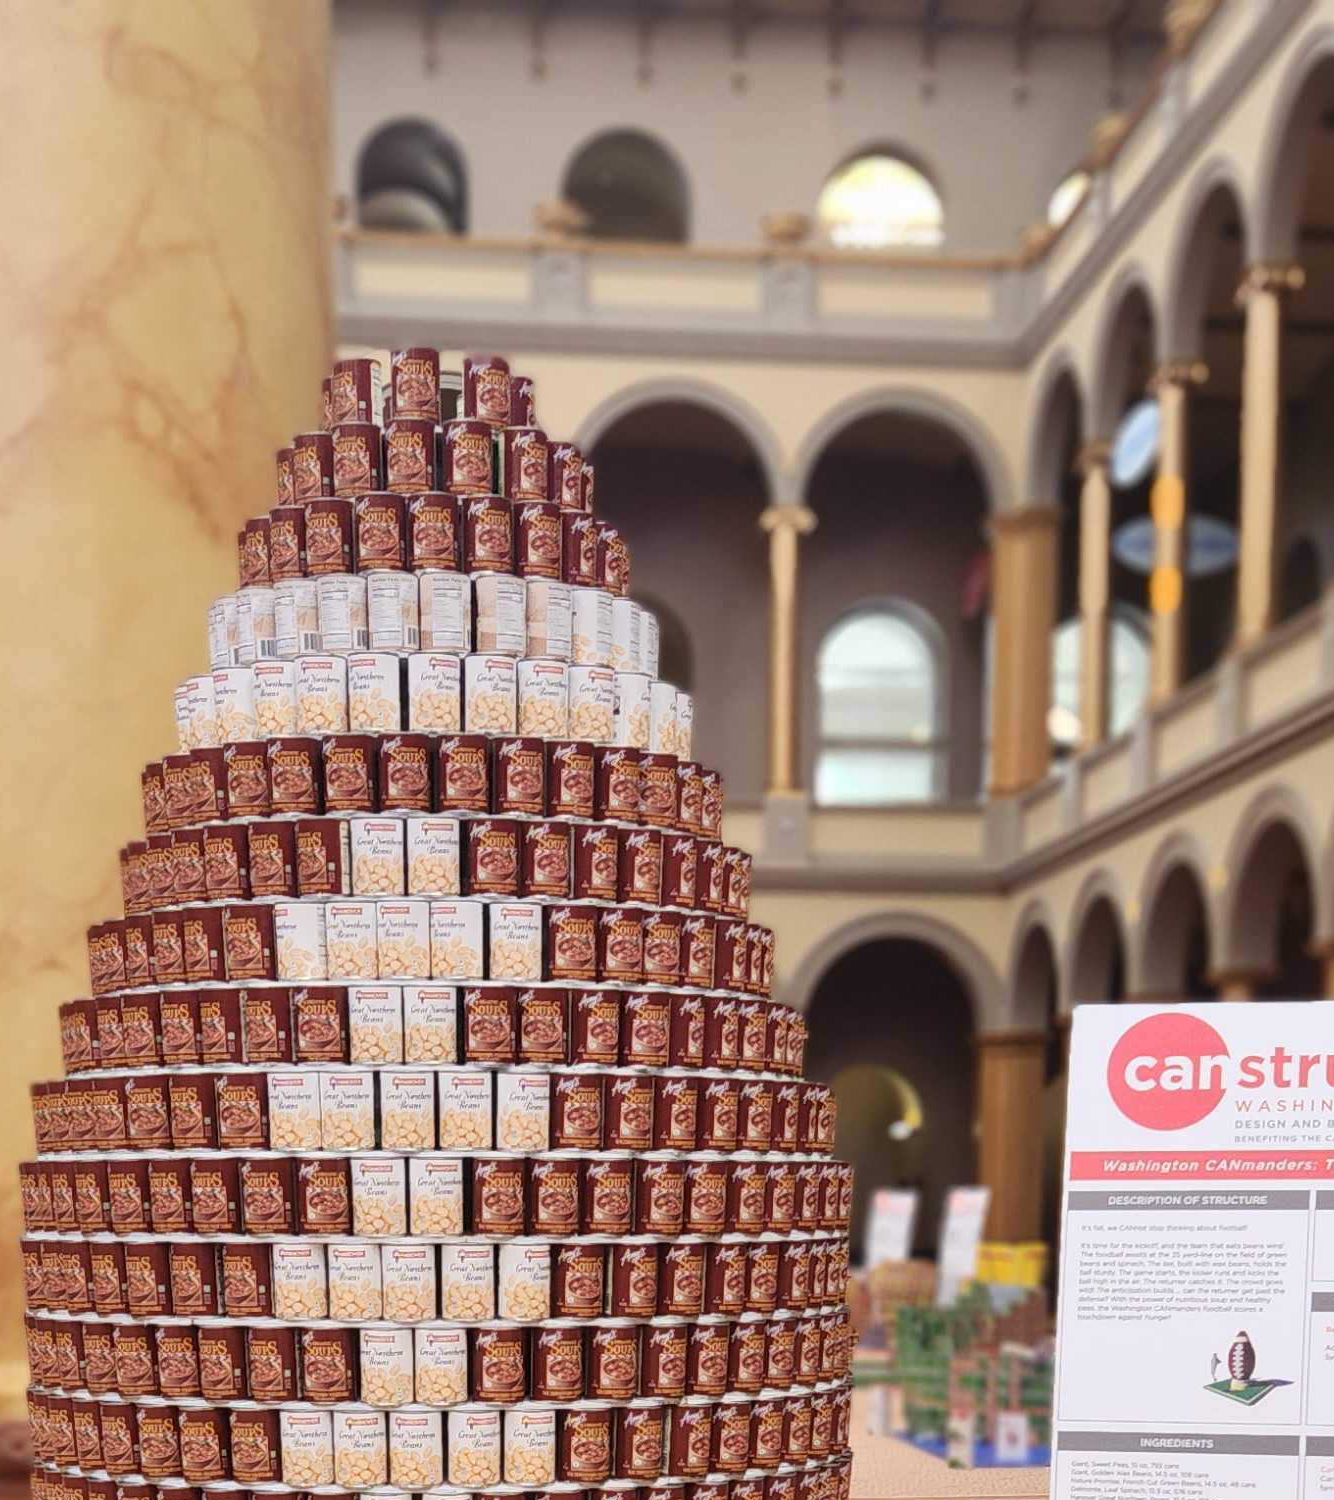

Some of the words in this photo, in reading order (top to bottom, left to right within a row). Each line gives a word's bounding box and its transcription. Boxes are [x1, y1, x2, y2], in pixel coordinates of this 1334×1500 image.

[1235, 1119, 1286, 1129] DESIGN
[1292, 1119, 1322, 1128] AND
[1235, 1135, 1298, 1143] BENEFITING
[1103, 1158, 1199, 1176] Washington
[1204, 1159, 1317, 1172] CANmanders:
[1107, 1194, 1182, 1207] DESCRIPTION
[1183, 1194, 1199, 1206] OF
[1201, 1194, 1268, 1206] STRUCTURE
[1140, 1438, 1214, 1448] INGREDIENTS
